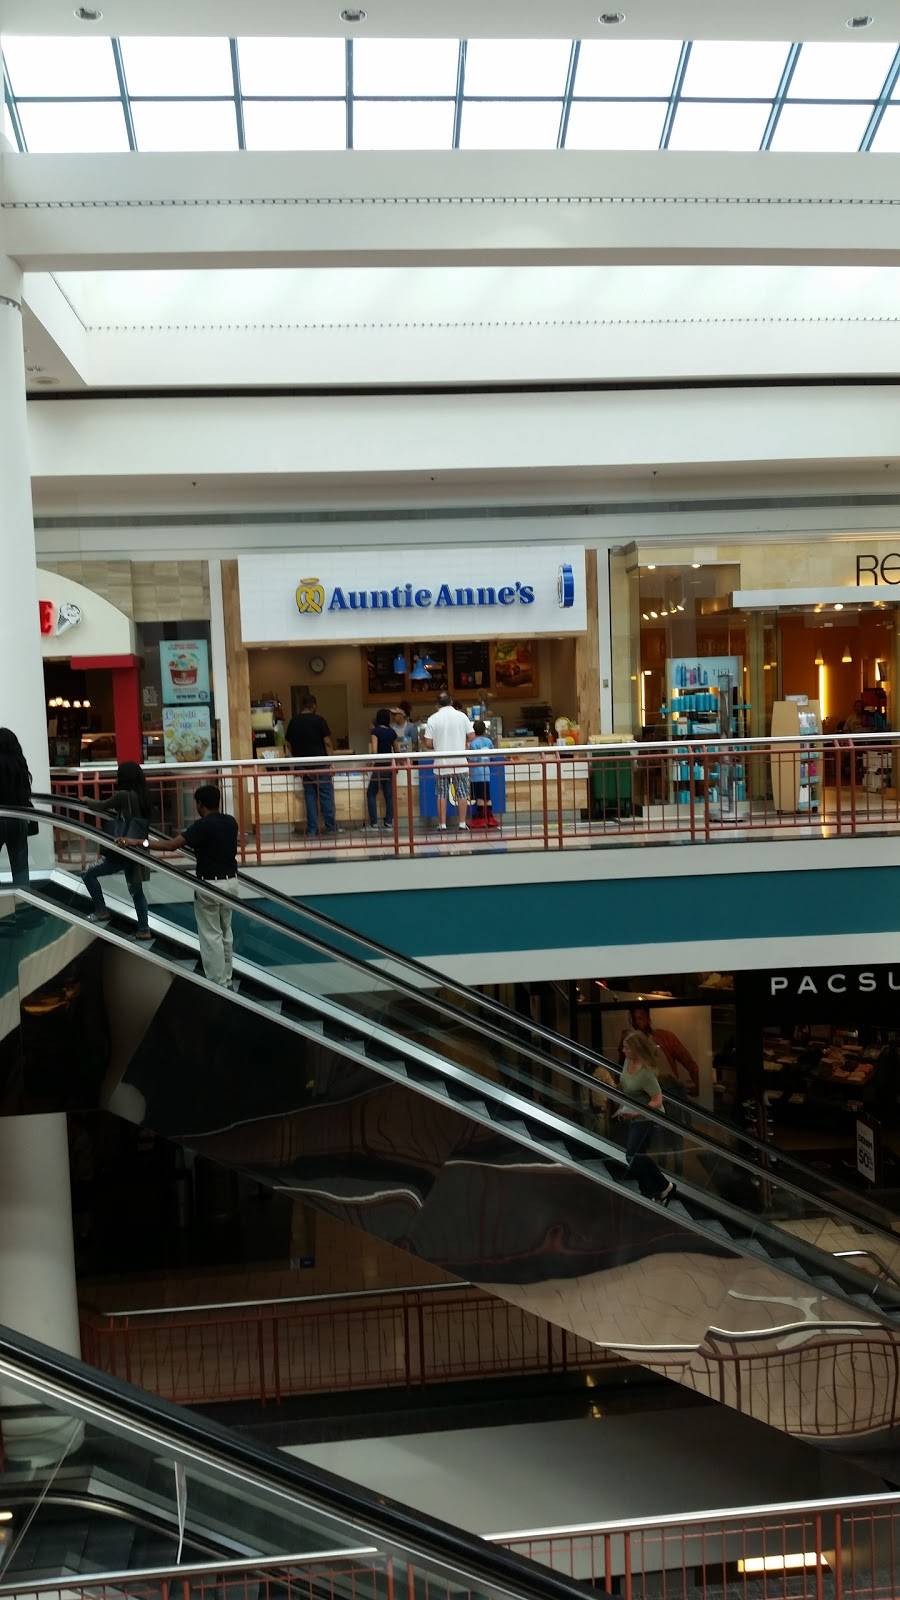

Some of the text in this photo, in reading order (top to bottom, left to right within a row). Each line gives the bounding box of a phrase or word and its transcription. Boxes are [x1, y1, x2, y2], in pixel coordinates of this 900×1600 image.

[328, 581, 535, 610] Auntie Anne's
[770, 971, 900, 996] PACSU
